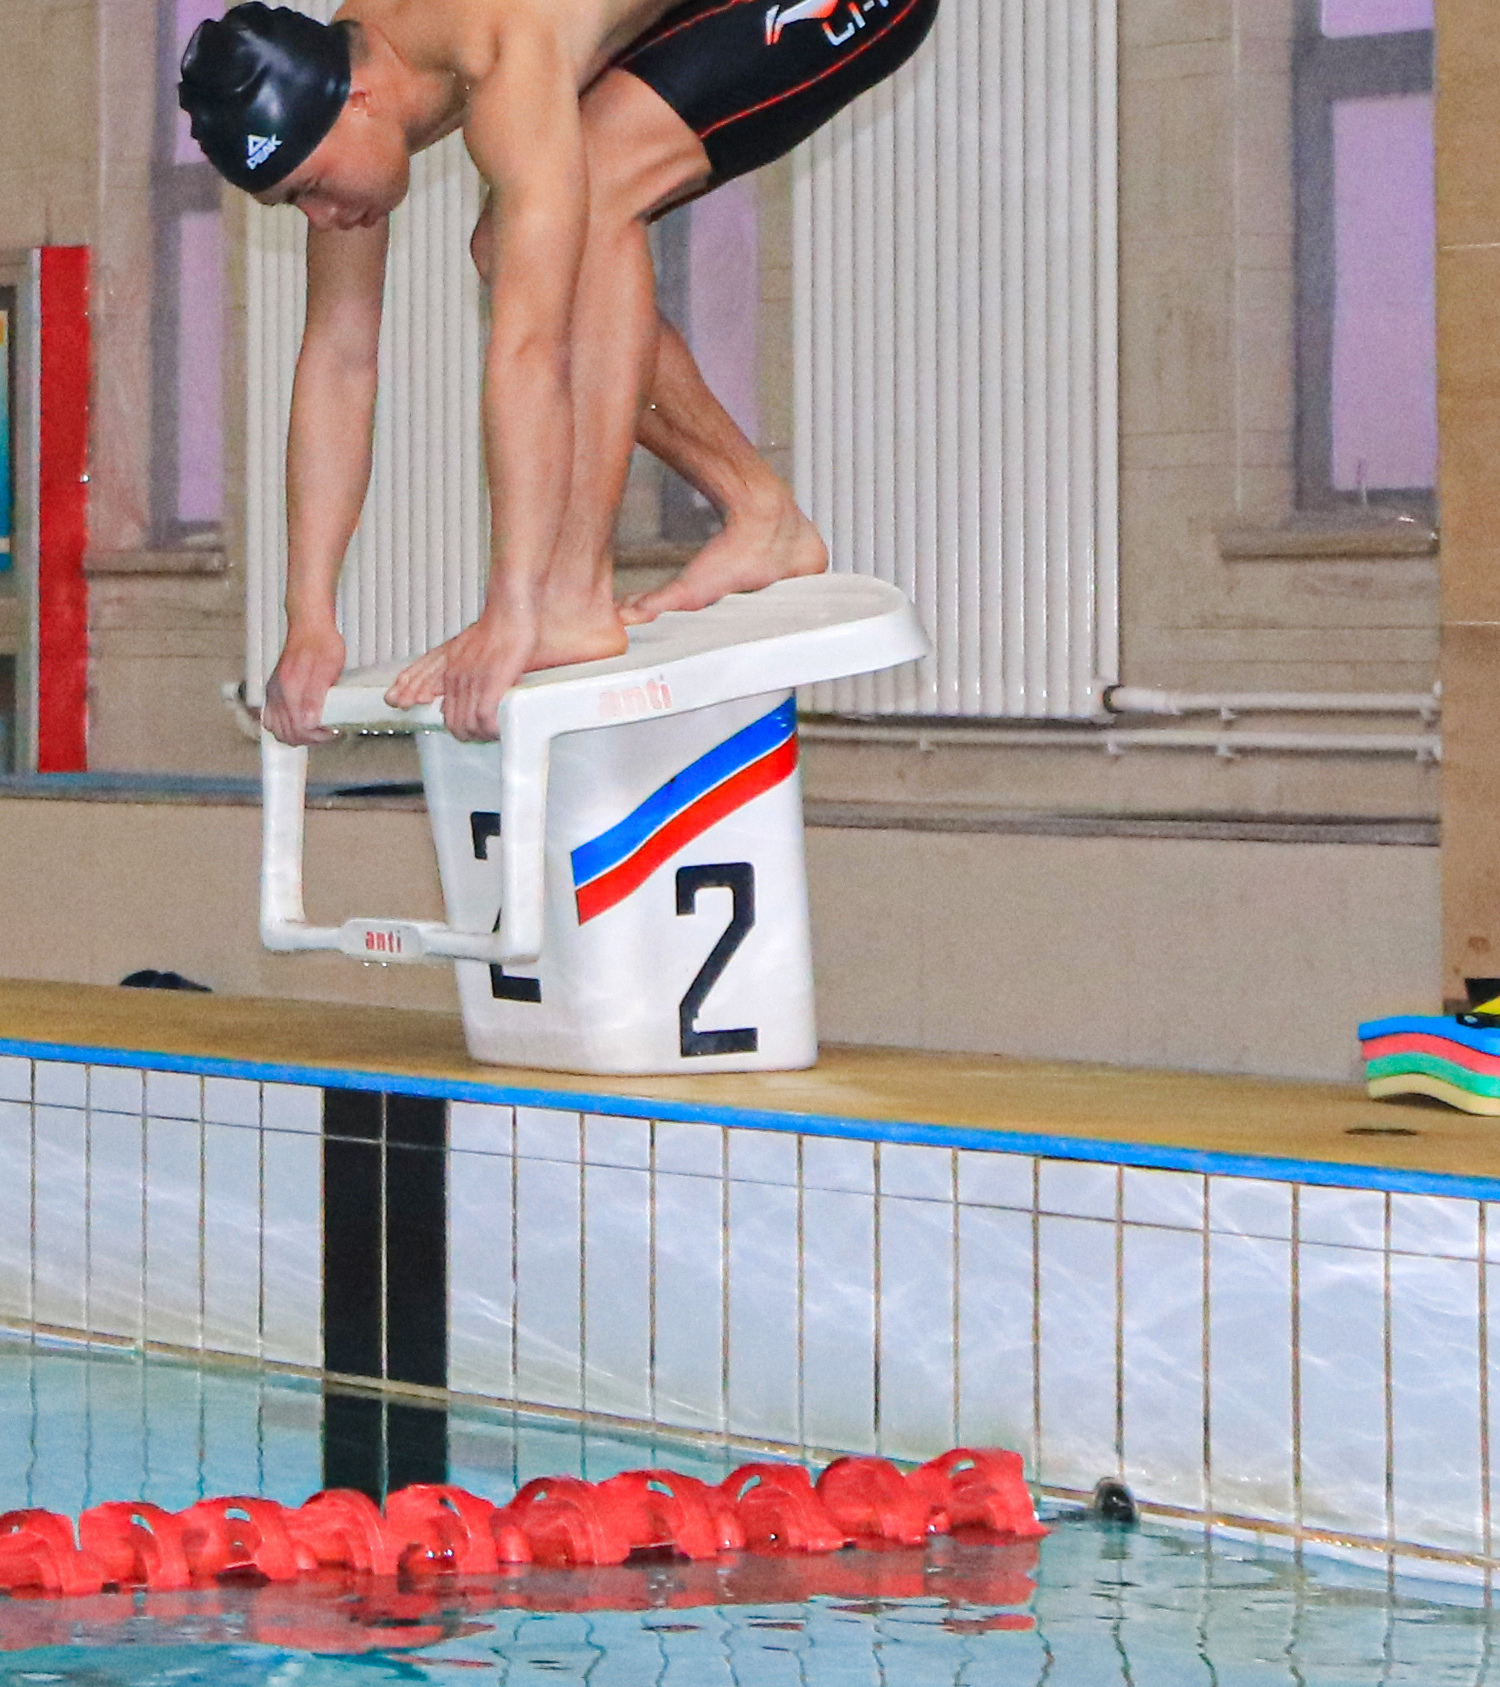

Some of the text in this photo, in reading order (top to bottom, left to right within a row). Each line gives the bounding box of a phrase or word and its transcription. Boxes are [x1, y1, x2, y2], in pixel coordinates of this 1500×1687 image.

[599, 673, 673, 717] anti
[365, 929, 402, 954] anti
[675, 861, 759, 1059] 2
